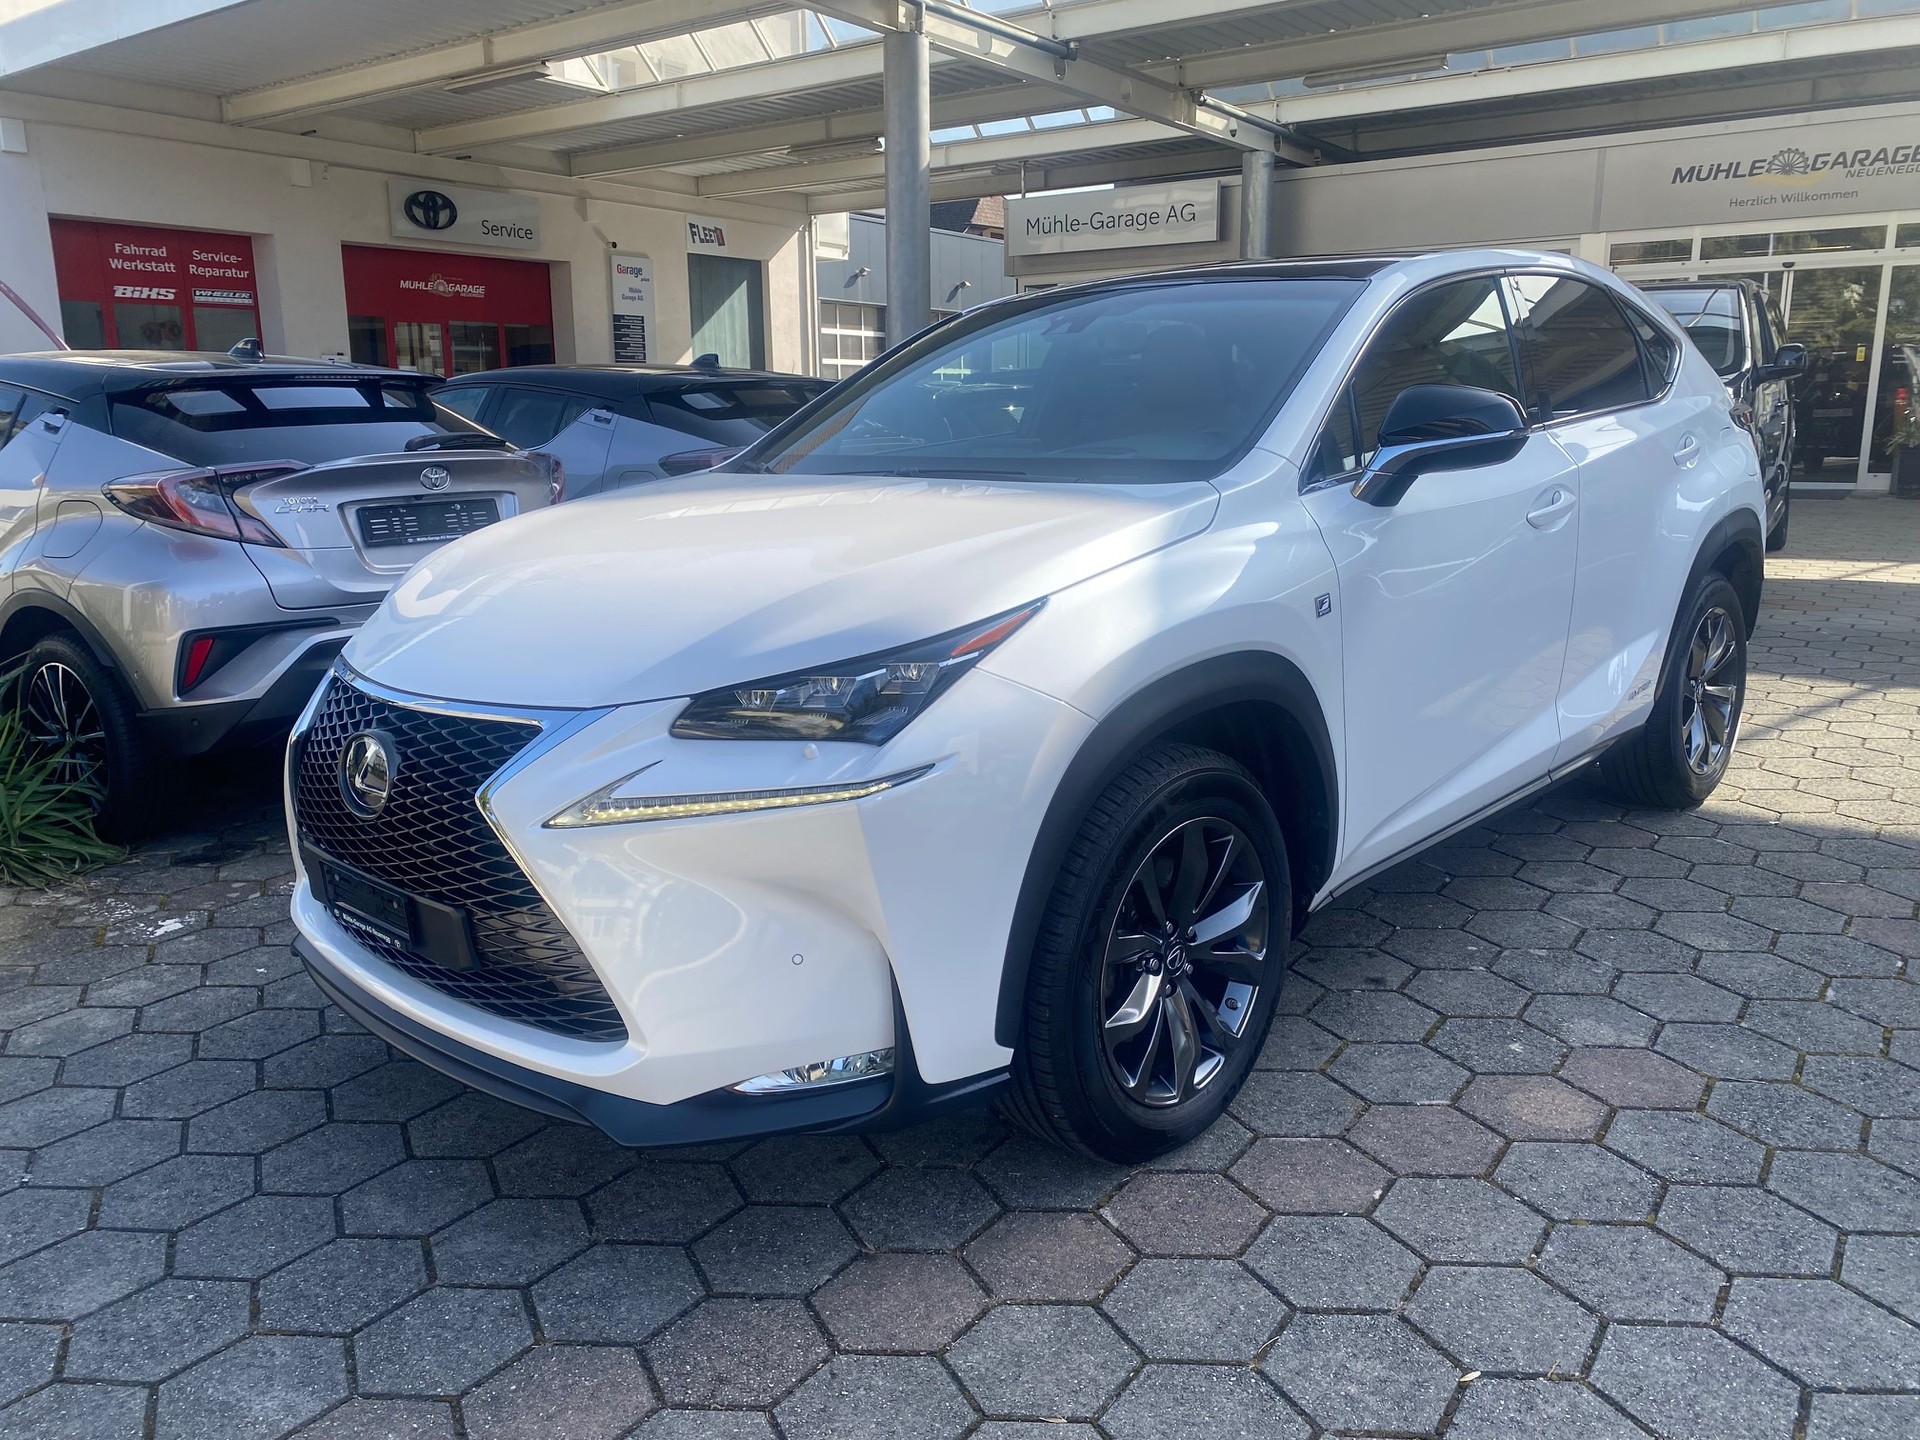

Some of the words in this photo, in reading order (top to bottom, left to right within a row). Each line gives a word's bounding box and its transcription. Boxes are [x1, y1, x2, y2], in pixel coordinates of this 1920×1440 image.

[1670, 158, 1767, 185] MÜHLE
[1810, 144, 1920, 171] GARAGE
[1729, 194, 1777, 208] Herzlich
[1781, 190, 1859, 204] Willkommen
[1026, 211, 1160, 236] Mühle-Garage
[1166, 203, 1196, 224] AG
[481, 219, 533, 240] Service
[114, 243, 167, 257] Fahrrad
[192, 250, 242, 263] Service-
[109, 258, 177, 273] Werkstatt
[189, 265, 249, 279] Reparatur
[616, 264, 643, 278] Garage
[448, 283, 486, 294] GARAGE
[282, 496, 318, 505] TOYOTA
